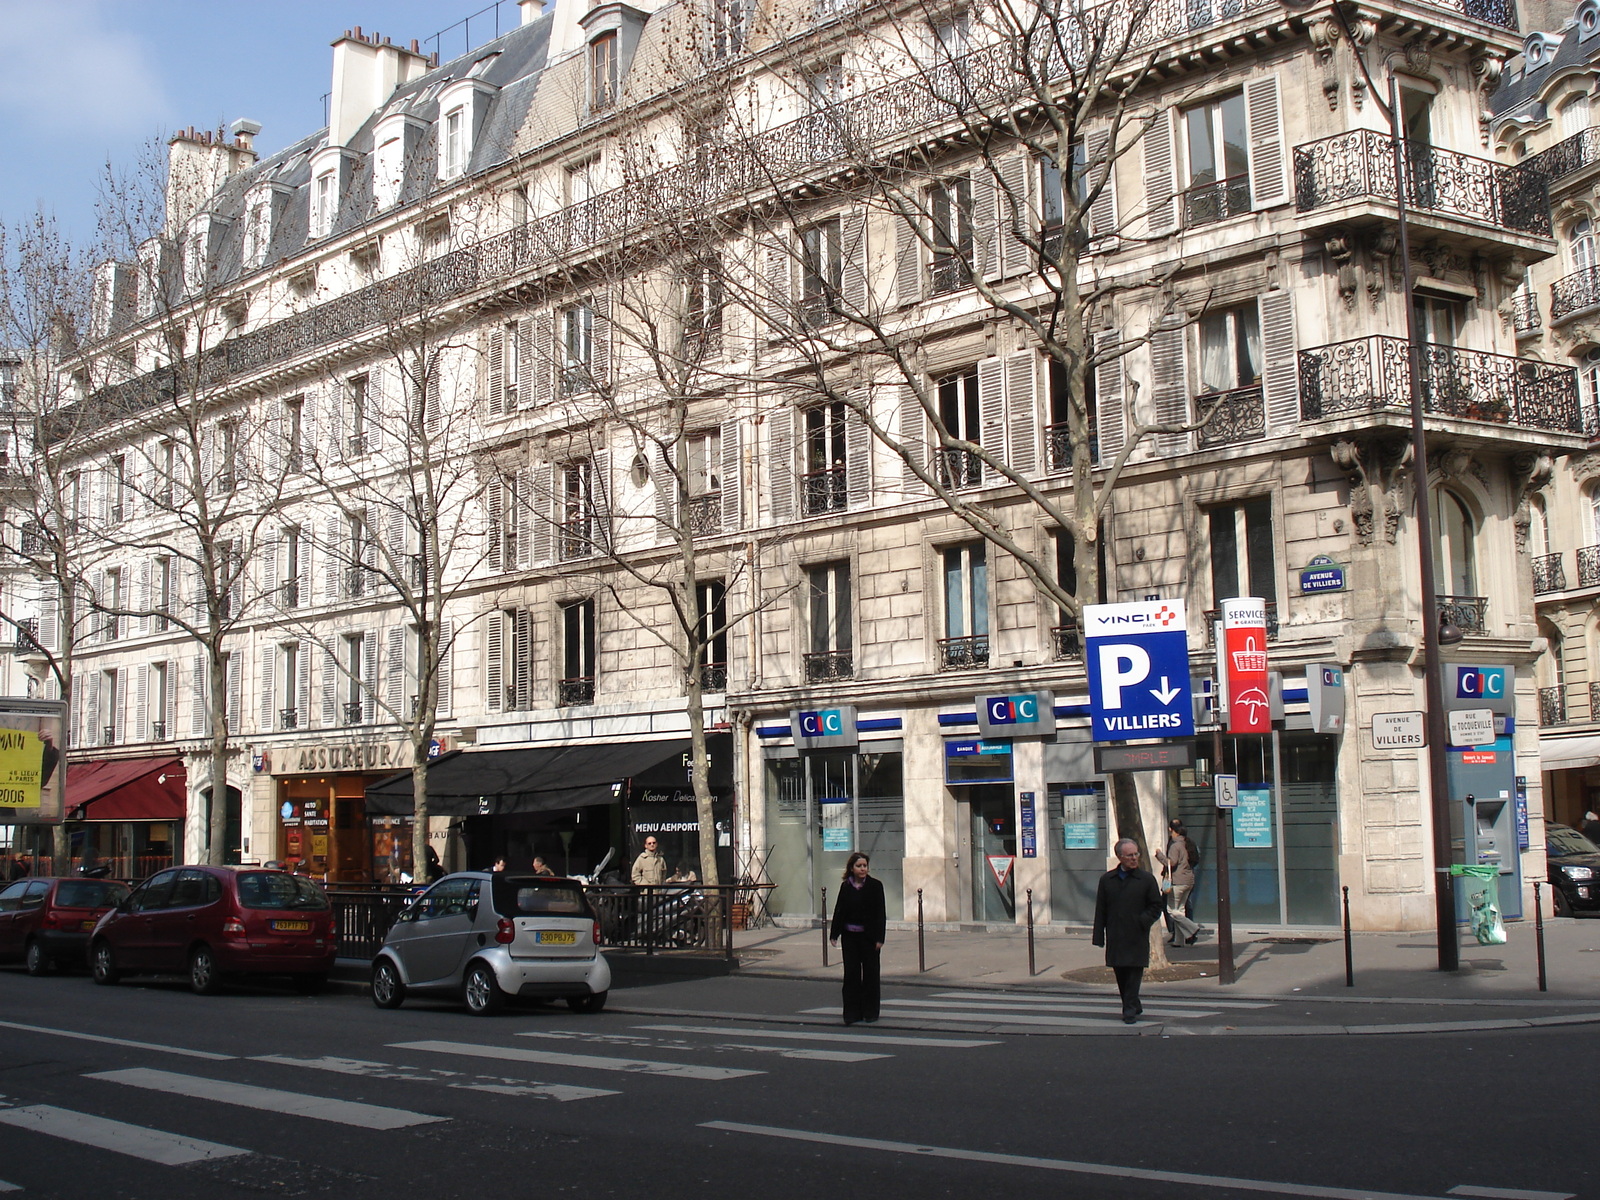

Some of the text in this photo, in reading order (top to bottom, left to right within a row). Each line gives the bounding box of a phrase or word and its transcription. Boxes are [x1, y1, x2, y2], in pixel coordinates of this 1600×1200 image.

[1310, 572, 1335, 580] AVENUE
[1303, 579, 1341, 589] DE VILLIERS
[1098, 614, 1150, 625] VINCI
[1098, 643, 1152, 711] P
[1324, 671, 1341, 685] CIC
[1461, 672, 1502, 695] CIC
[991, 700, 1035, 721] CIC
[803, 714, 839, 733] CIC
[1103, 713, 1182, 731] VILLIERS
[1457, 720, 1492, 731] TOCQUEVILLE
[1376, 734, 1421, 744] VILLIERS
[298, 746, 392, 771] ASSUREUR
[0, 788, 25, 803] 2006
[642, 790, 669, 802] Kosher
[635, 823, 659, 832] MENU
[660, 822, 700, 832] AEMPORT
